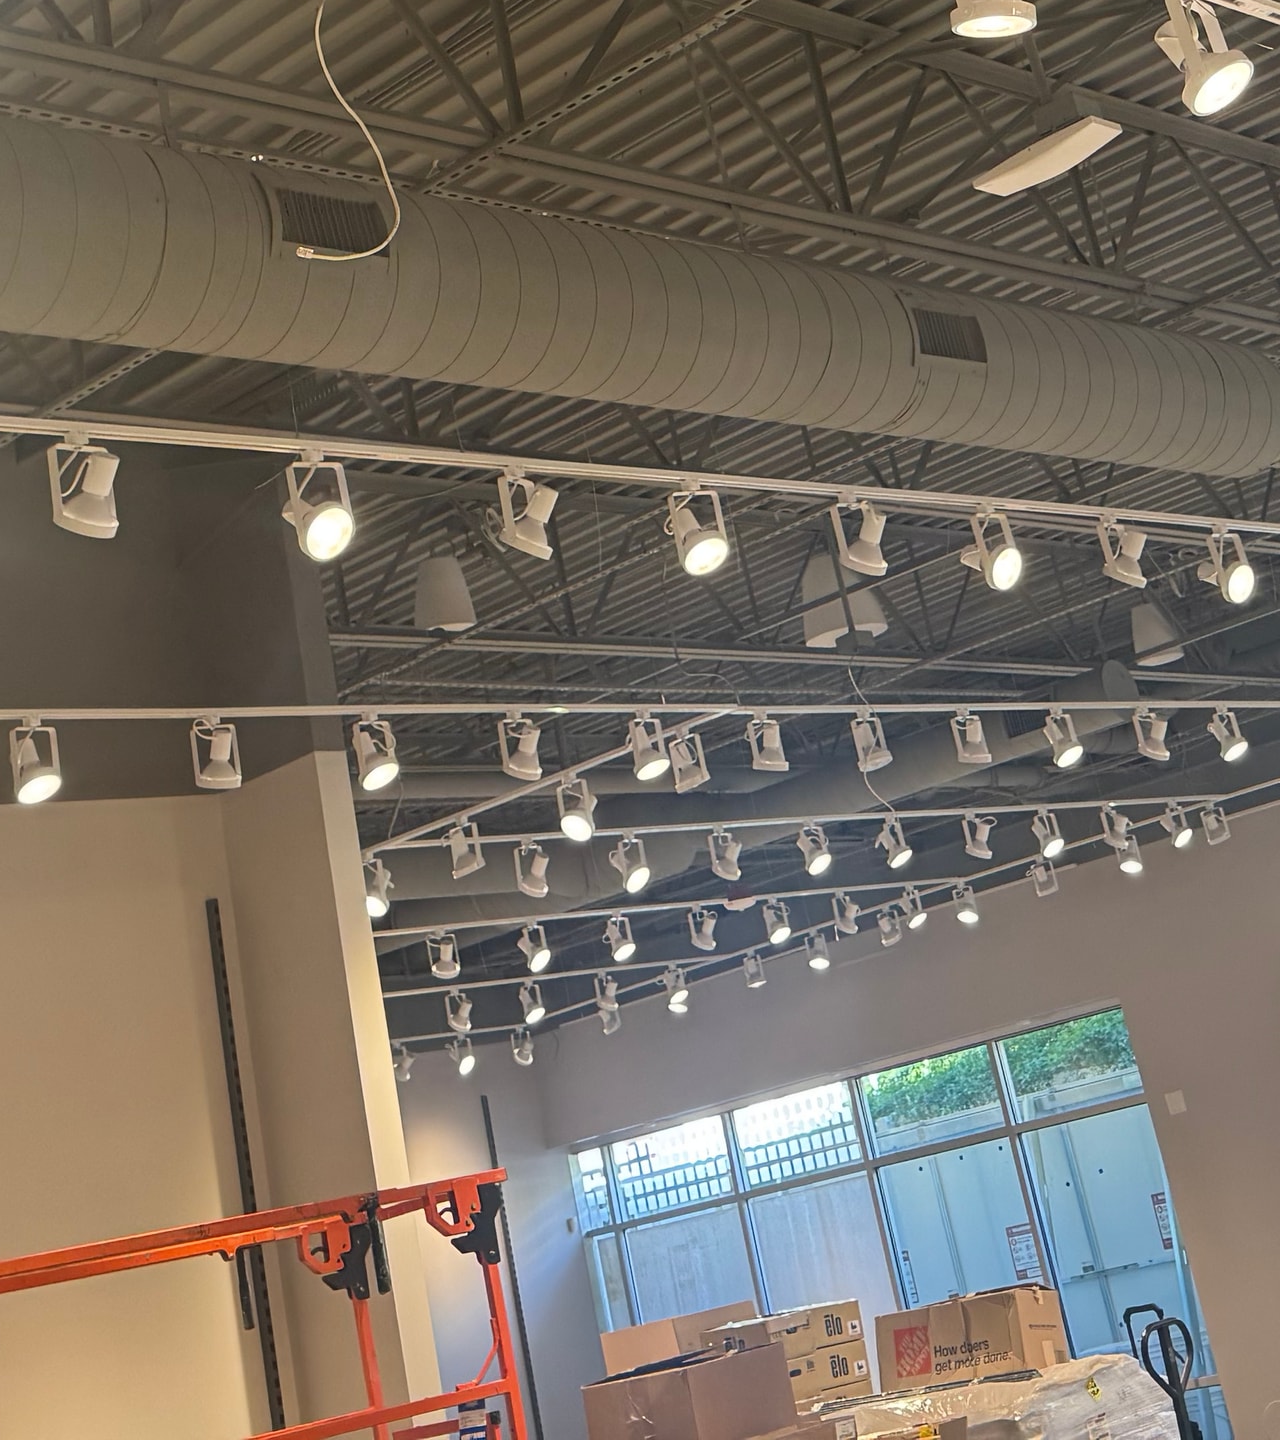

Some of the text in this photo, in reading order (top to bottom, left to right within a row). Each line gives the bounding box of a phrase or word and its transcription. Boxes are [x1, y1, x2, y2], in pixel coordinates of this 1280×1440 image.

[934, 1339, 990, 1358] How doers
[934, 1359, 952, 1375] get
[954, 1355, 981, 1370] more
